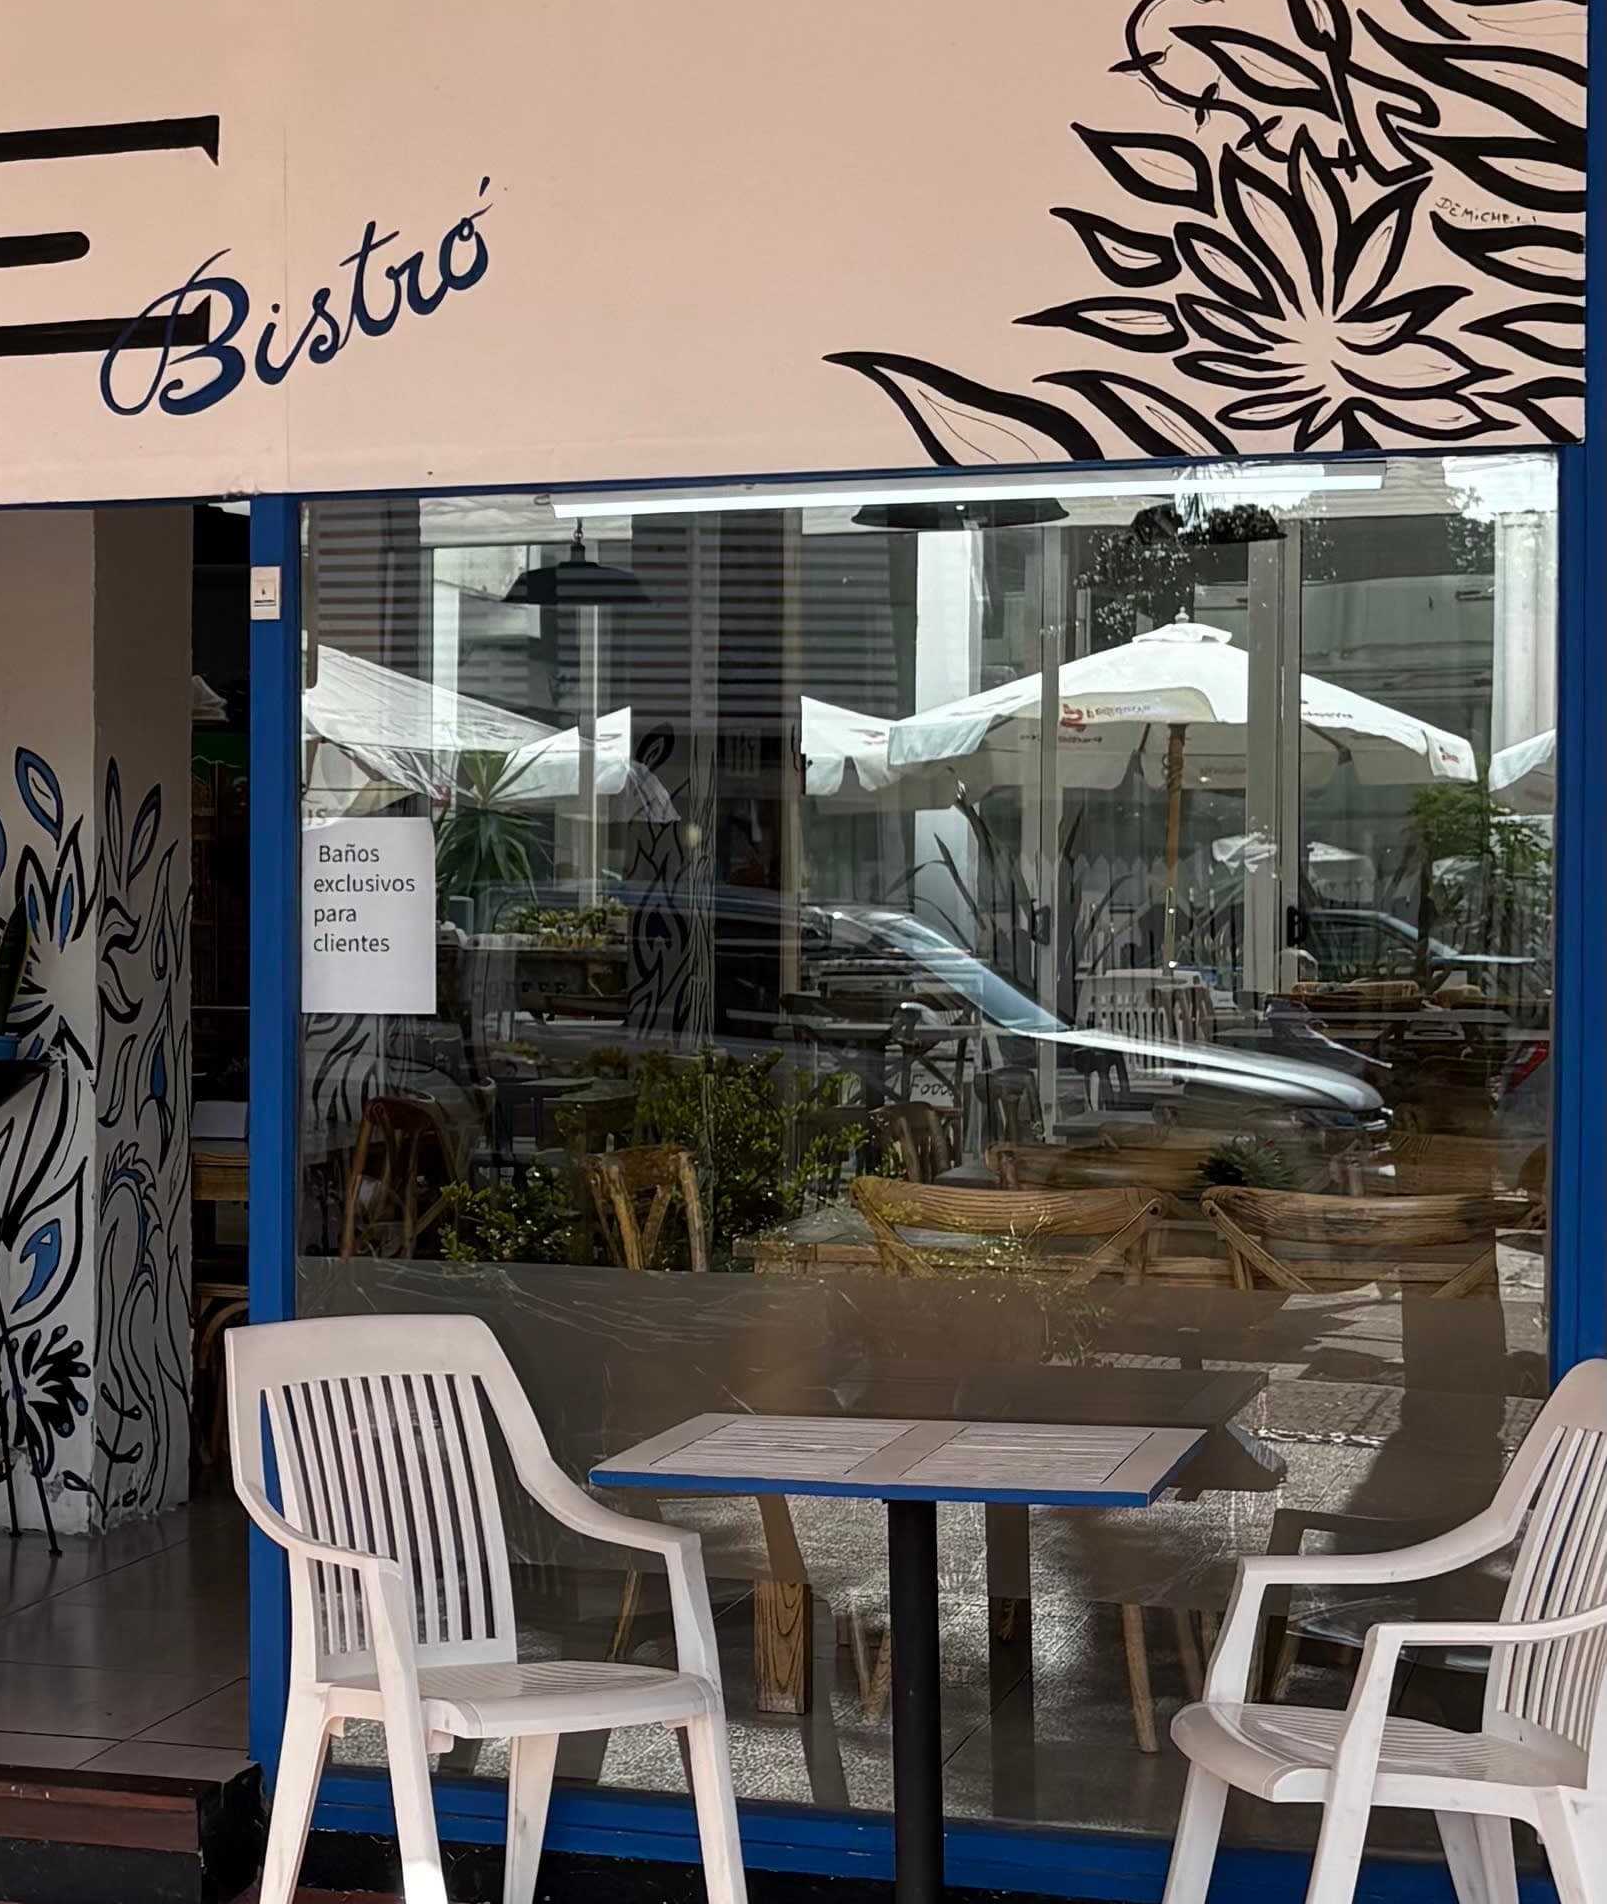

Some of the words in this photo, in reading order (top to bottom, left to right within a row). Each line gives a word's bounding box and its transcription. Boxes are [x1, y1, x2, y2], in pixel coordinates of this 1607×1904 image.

[100, 176, 494, 416] Bistró
[318, 843, 380, 863] Baños
[313, 873, 416, 893] exclusivos
[313, 907, 357, 927] para
[313, 933, 391, 953] clientes
